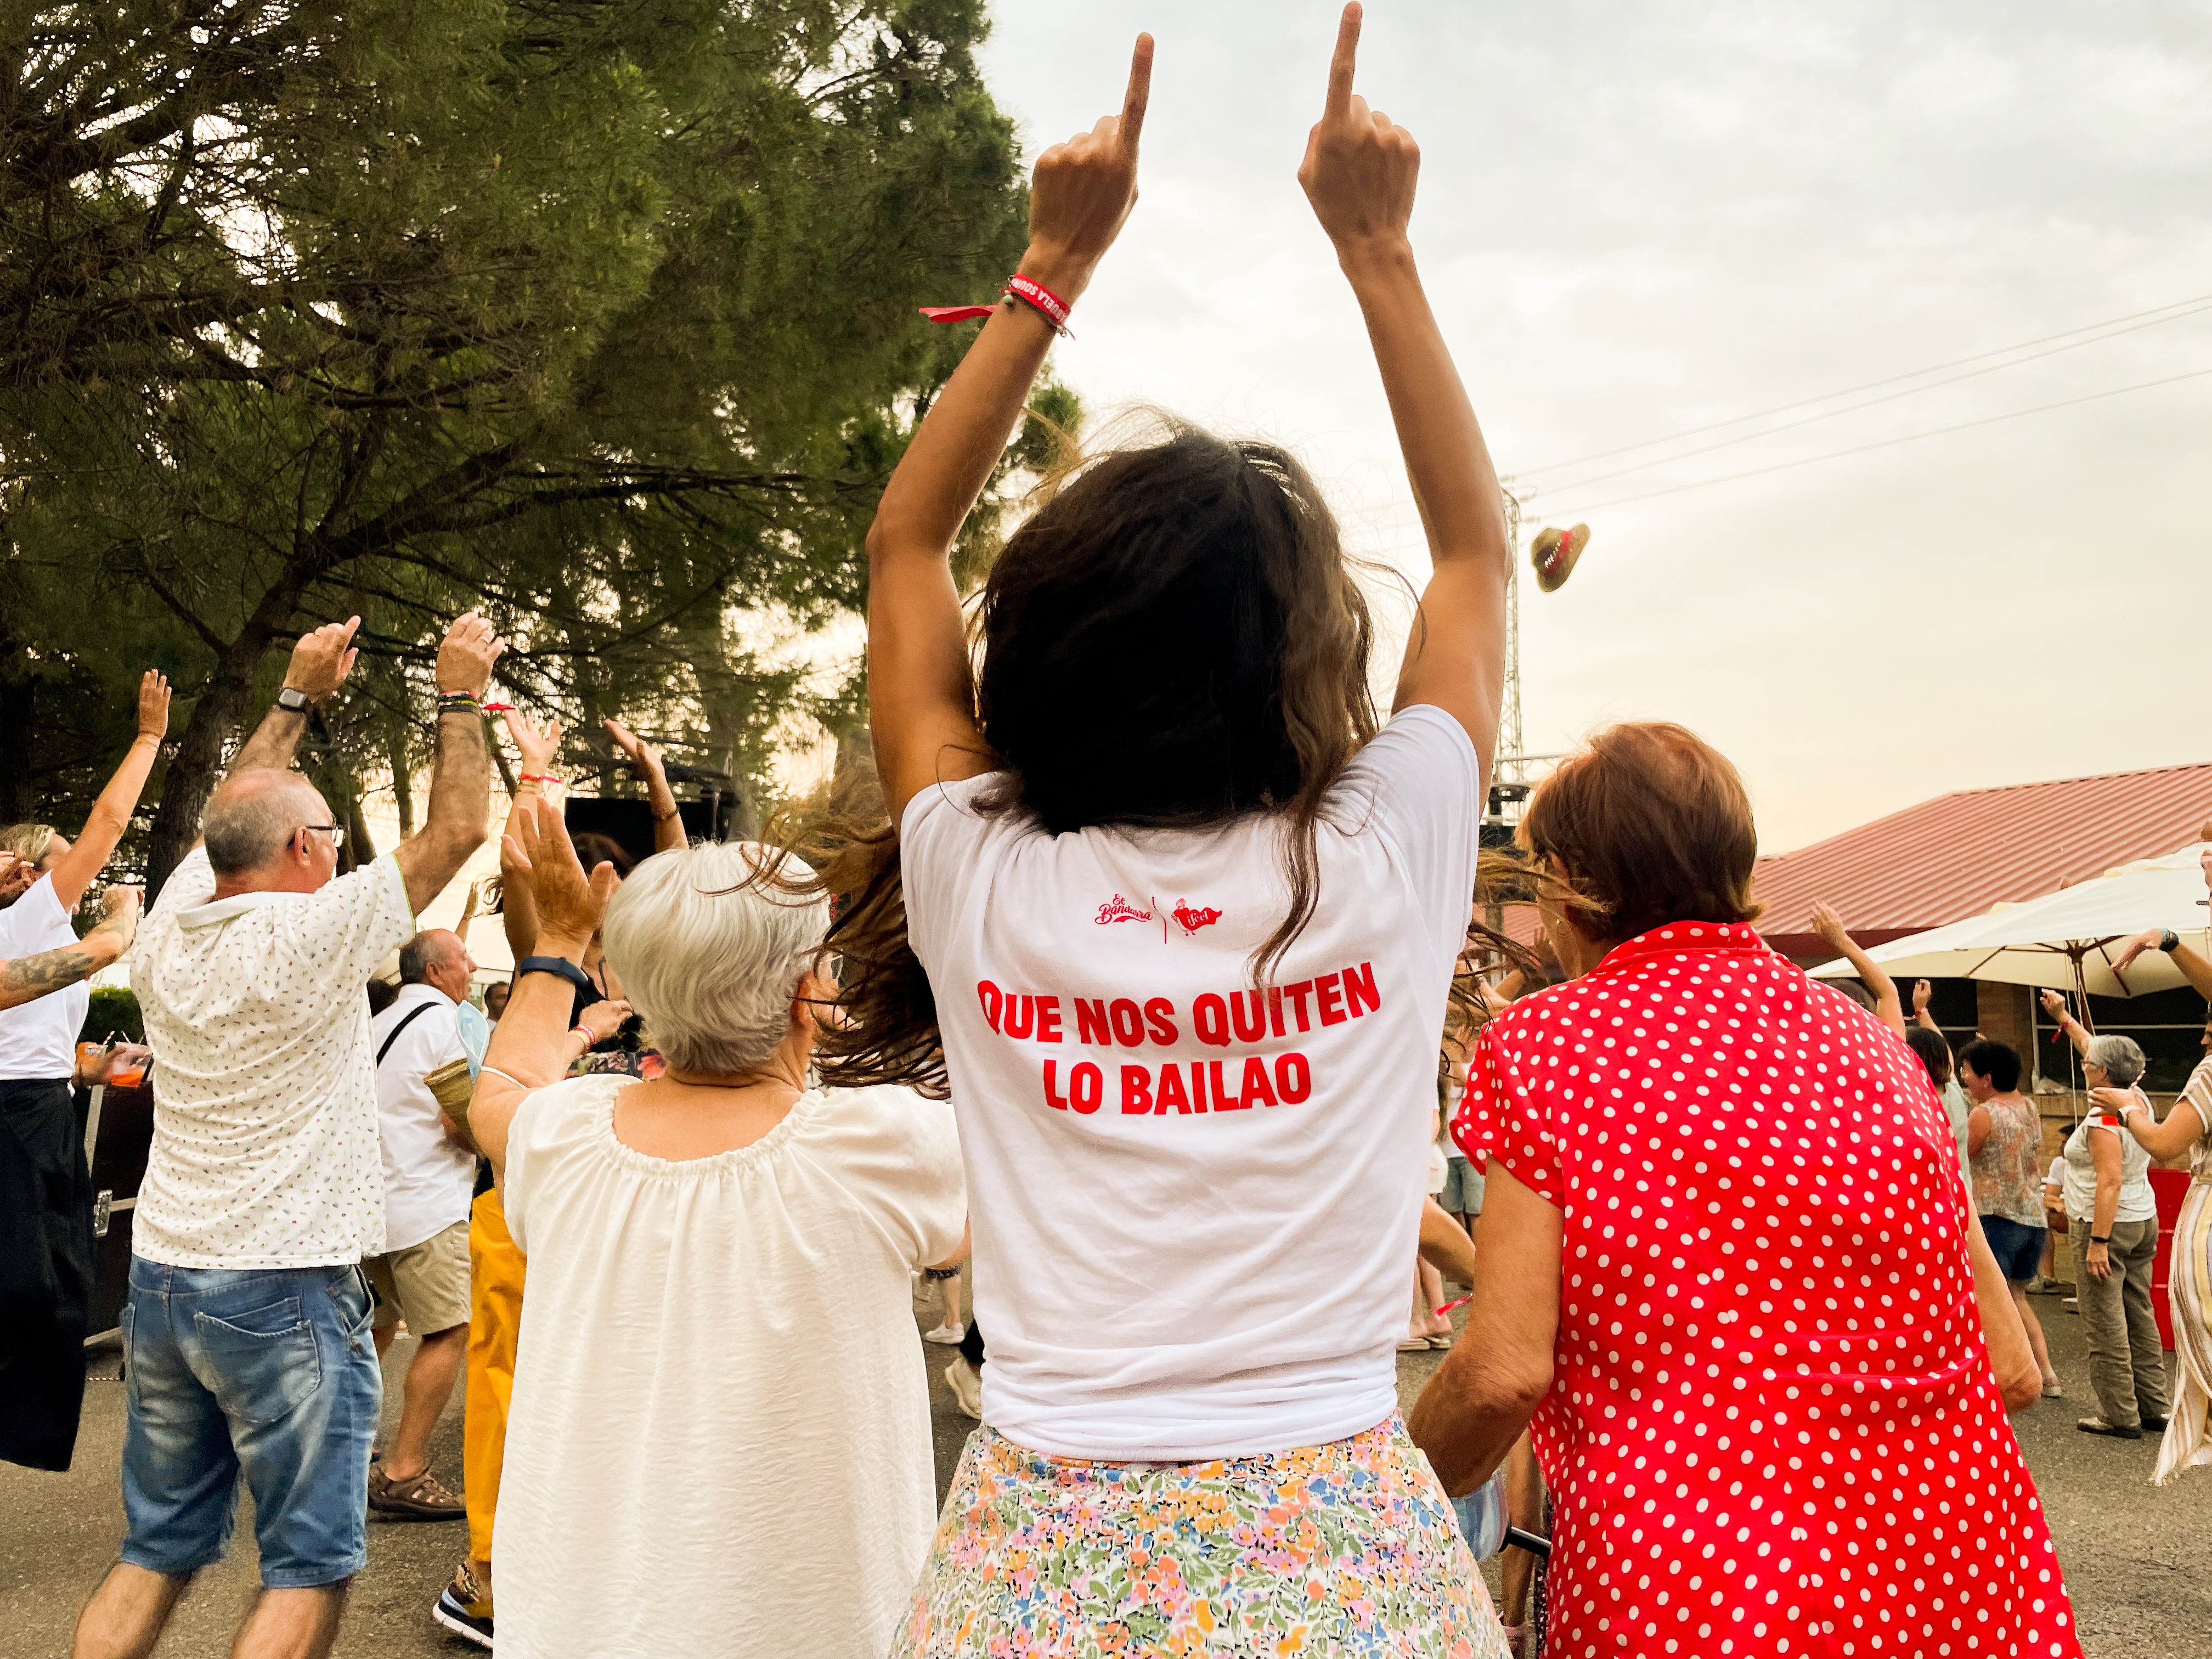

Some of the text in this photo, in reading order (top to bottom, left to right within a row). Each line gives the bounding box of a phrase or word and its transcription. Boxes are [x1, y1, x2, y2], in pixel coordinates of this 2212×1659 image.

[977, 962, 1381, 1048] QUE NOS QUITEN
[1043, 1052, 1311, 1115] LO BAILAO
